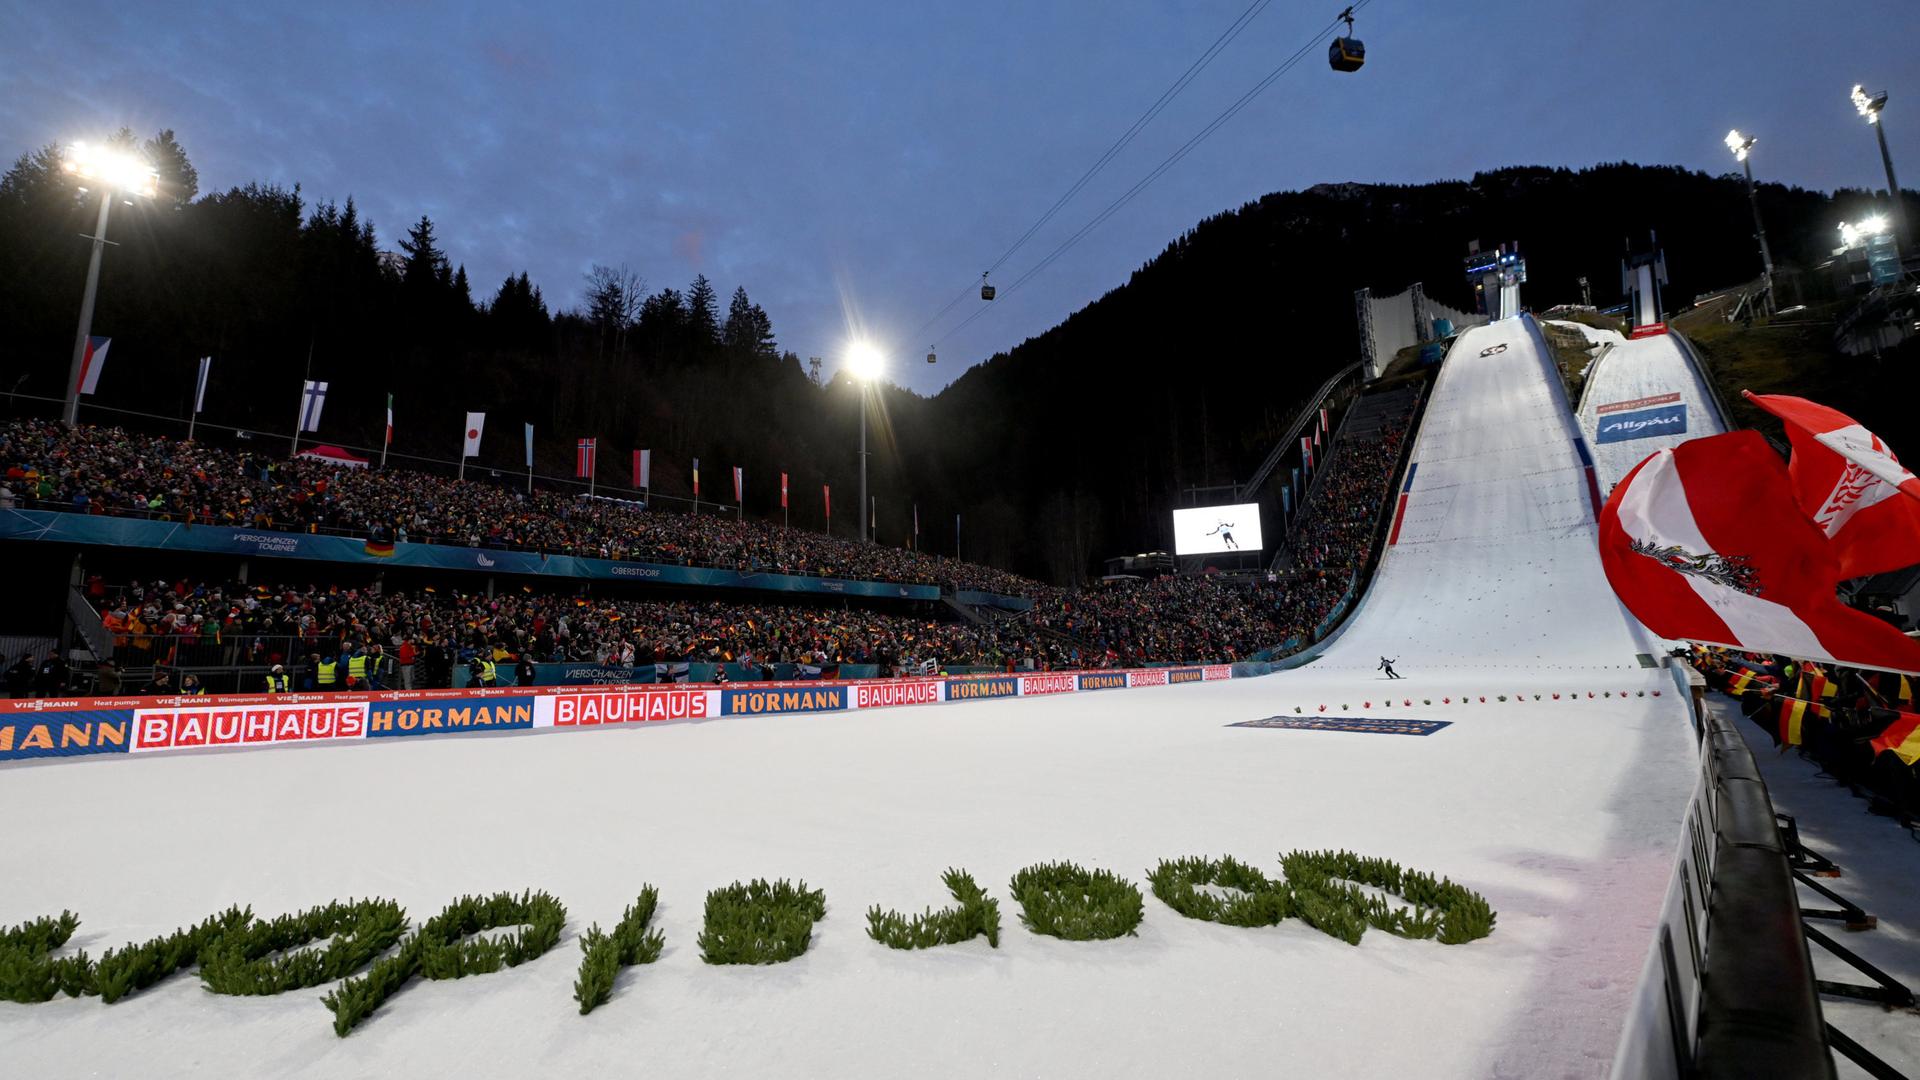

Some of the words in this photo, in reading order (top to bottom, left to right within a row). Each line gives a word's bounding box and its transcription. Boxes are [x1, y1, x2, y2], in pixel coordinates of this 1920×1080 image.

[1602, 414, 1680, 433] Allgäu
[233, 534, 299, 545] VIERSCHANZEN
[258, 543, 297, 552] TOURNEE
[611, 566, 661, 577] OBERSTDORF
[565, 669, 634, 679] VIERSCHANZEN
[1082, 676, 1124, 689] HÖRMANN
[1131, 673, 1166, 685] BAUHAUS
[951, 681, 1013, 699] HÖRMANN
[1024, 677, 1073, 693] BAUHAUS
[13, 699, 79, 711] VIESSMANN
[156, 696, 211, 707] VIESSMANN
[218, 695, 267, 703] Wärmepumpen
[277, 693, 324, 704] VIESSMANN
[732, 691, 840, 714] HÖRMANN
[858, 684, 937, 706] BAUHAUS
[558, 694, 705, 724] BAUHAUS
[142, 711, 361, 744] BAUHAUS
[371, 704, 532, 733] HÖRMANN
